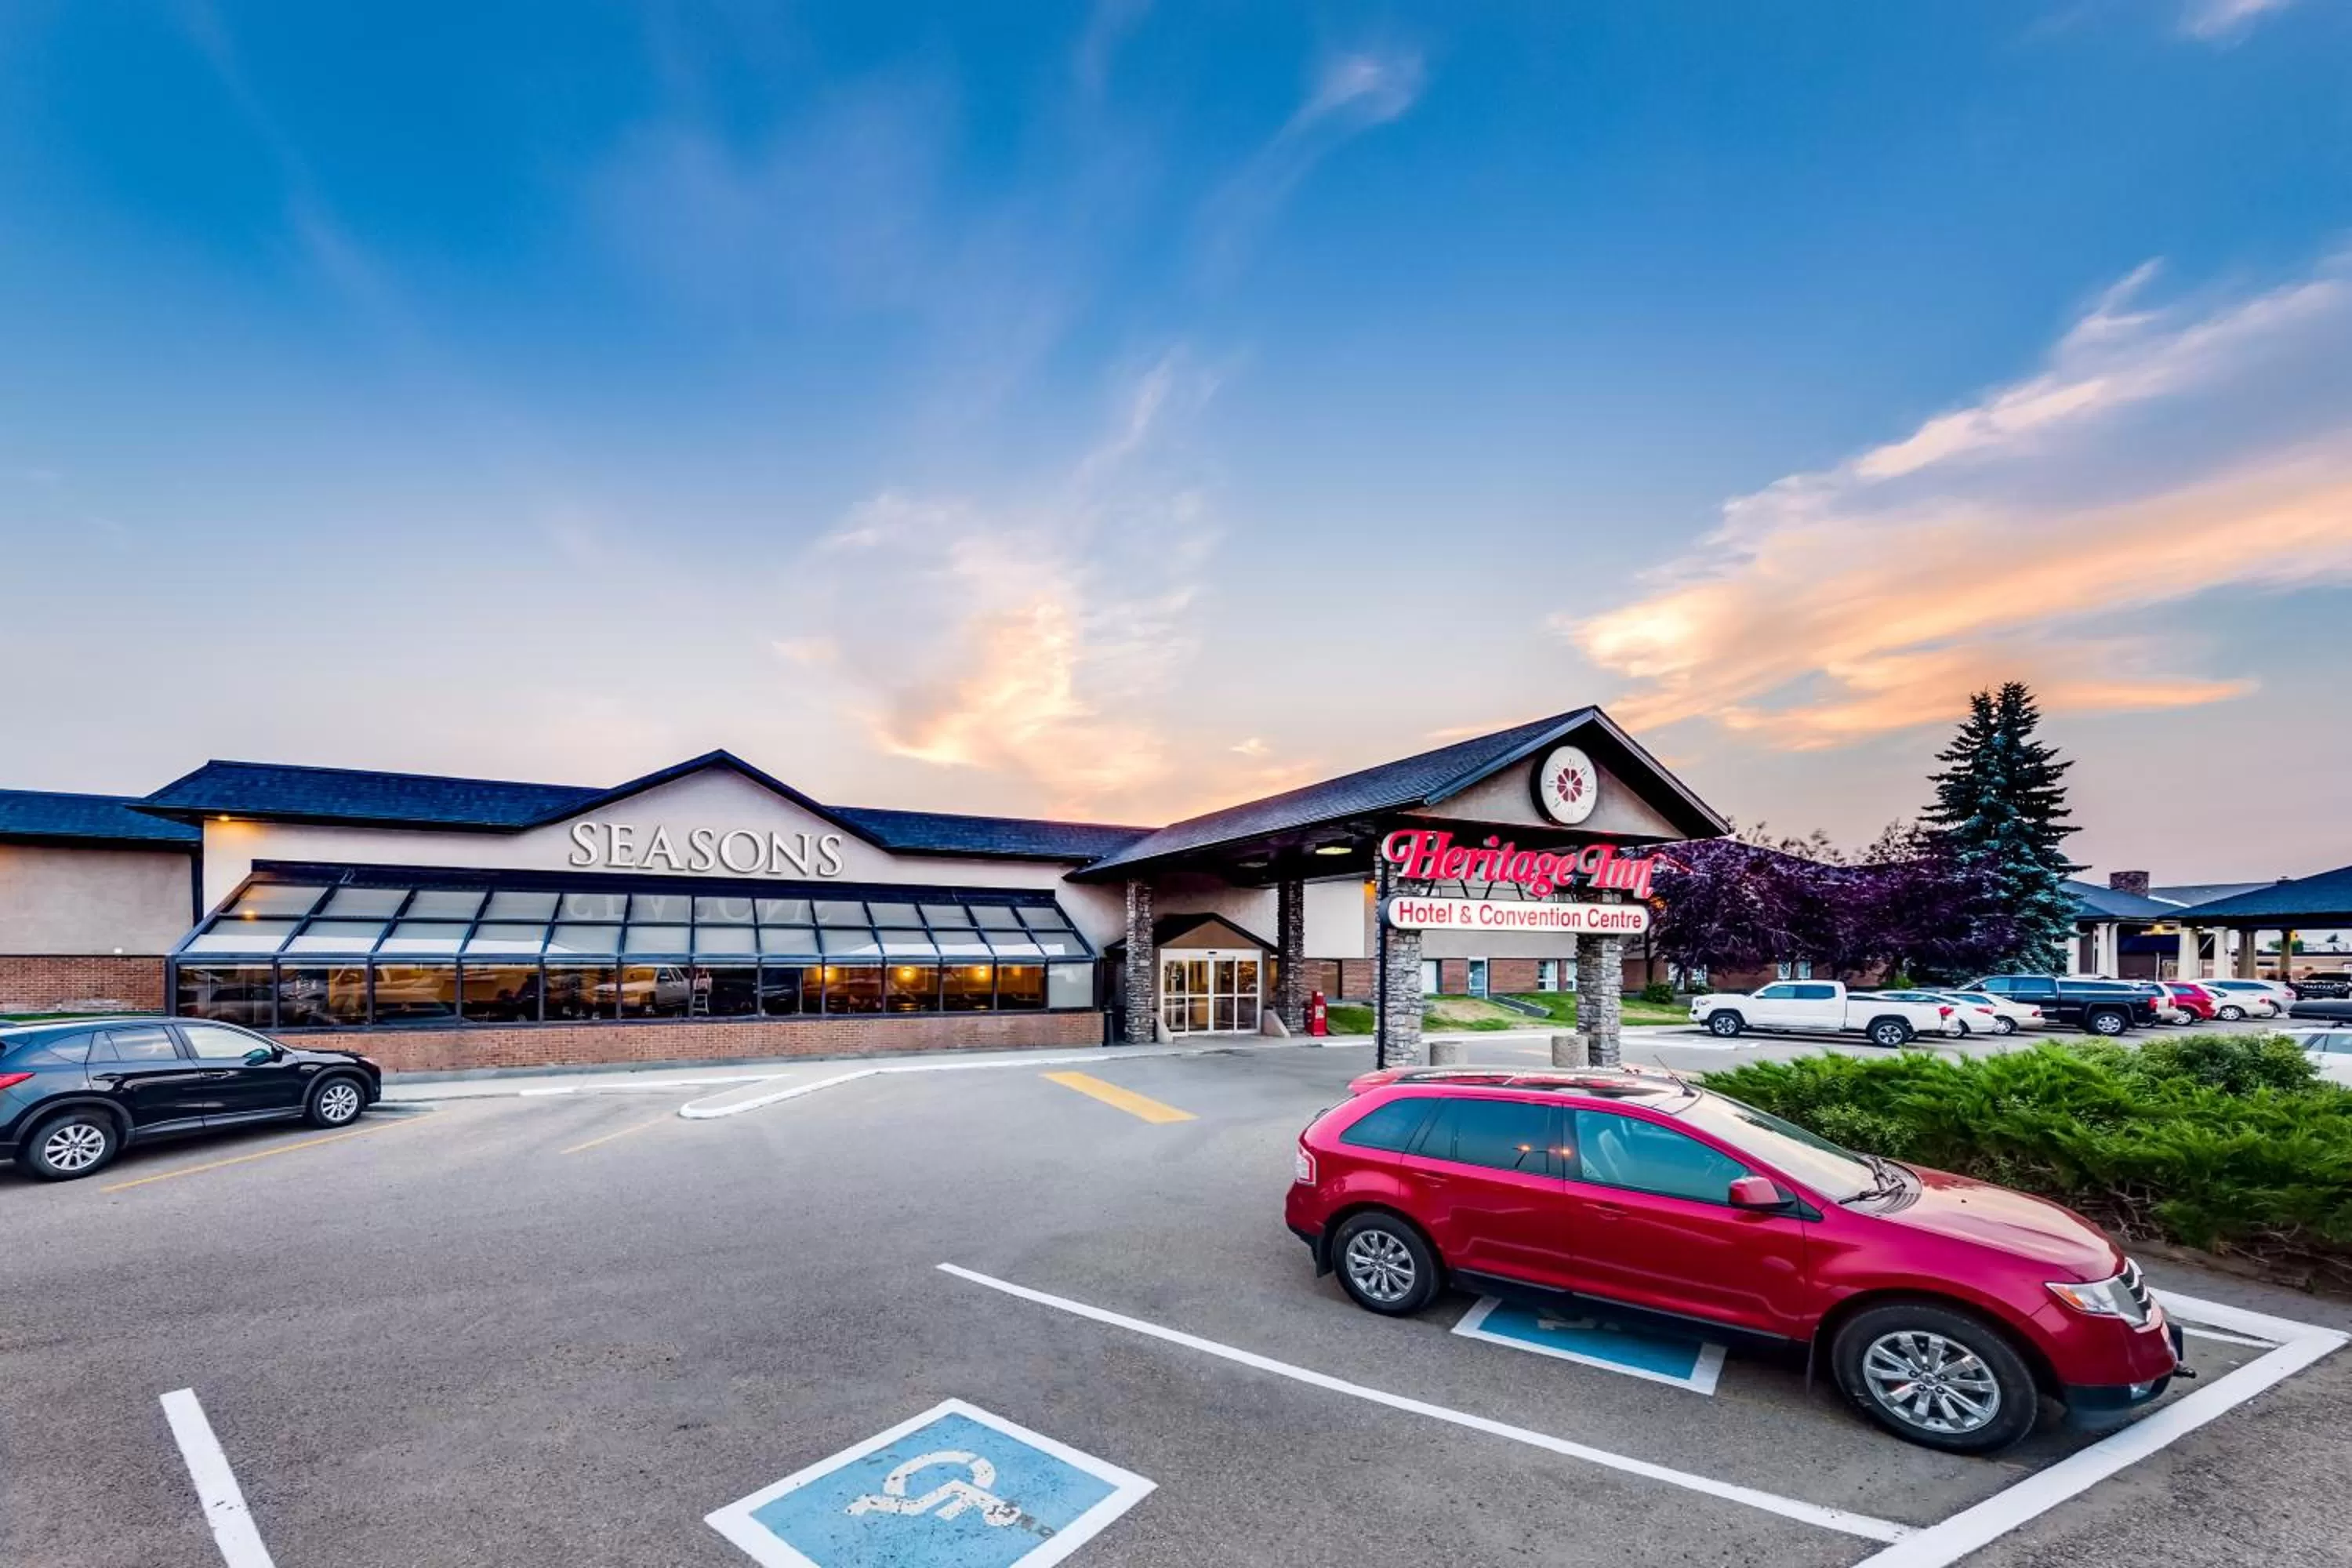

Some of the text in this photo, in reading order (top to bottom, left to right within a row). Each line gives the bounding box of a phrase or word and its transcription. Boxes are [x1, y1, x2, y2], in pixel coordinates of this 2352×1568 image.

[571, 822, 844, 877] SEASONS
[1382, 829, 1654, 899] Heritage Inn
[1399, 902, 1642, 928] Hotel & Convention Centre
